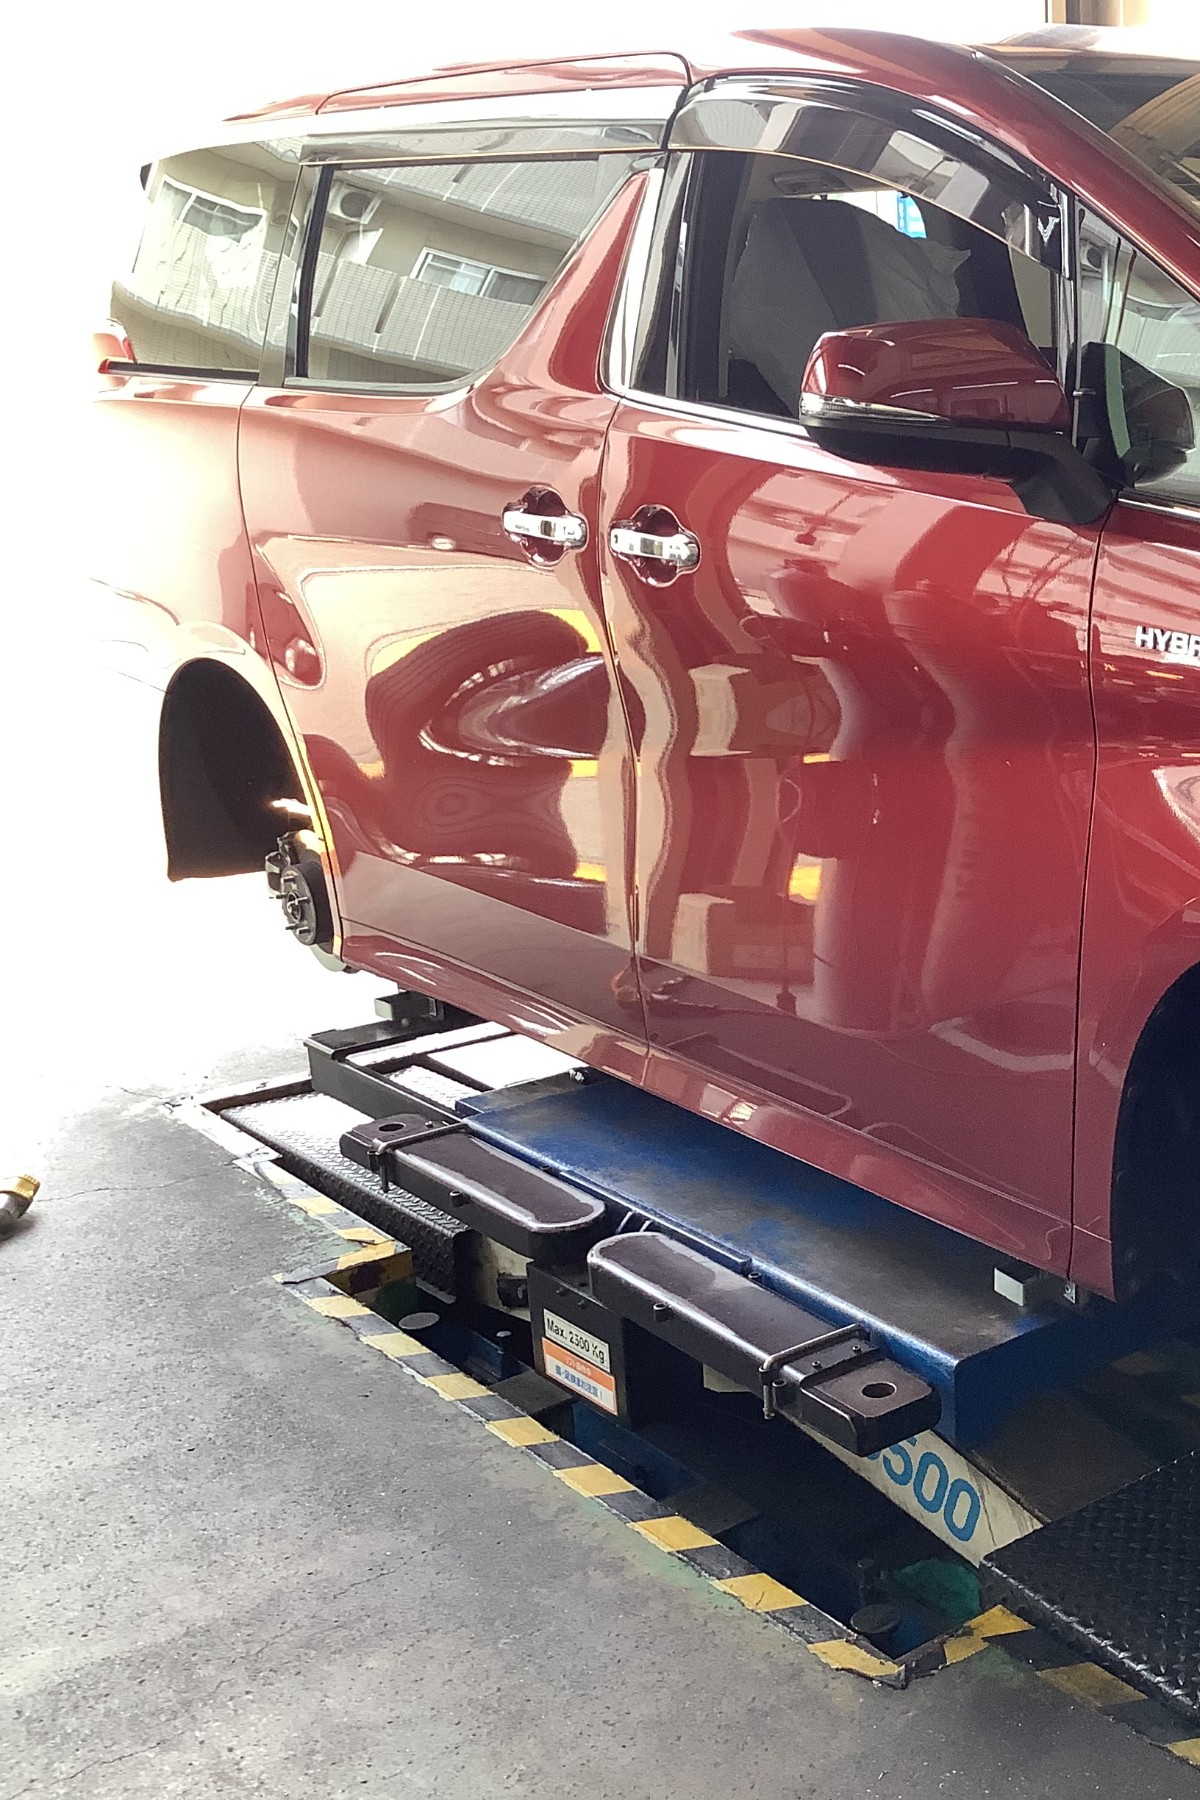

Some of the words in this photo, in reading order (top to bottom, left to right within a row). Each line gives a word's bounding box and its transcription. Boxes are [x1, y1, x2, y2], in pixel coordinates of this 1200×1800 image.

[547, 1318, 568, 1340] Max.
[591, 1343, 605, 1364] Kg
[867, 1435, 982, 1542] 500
